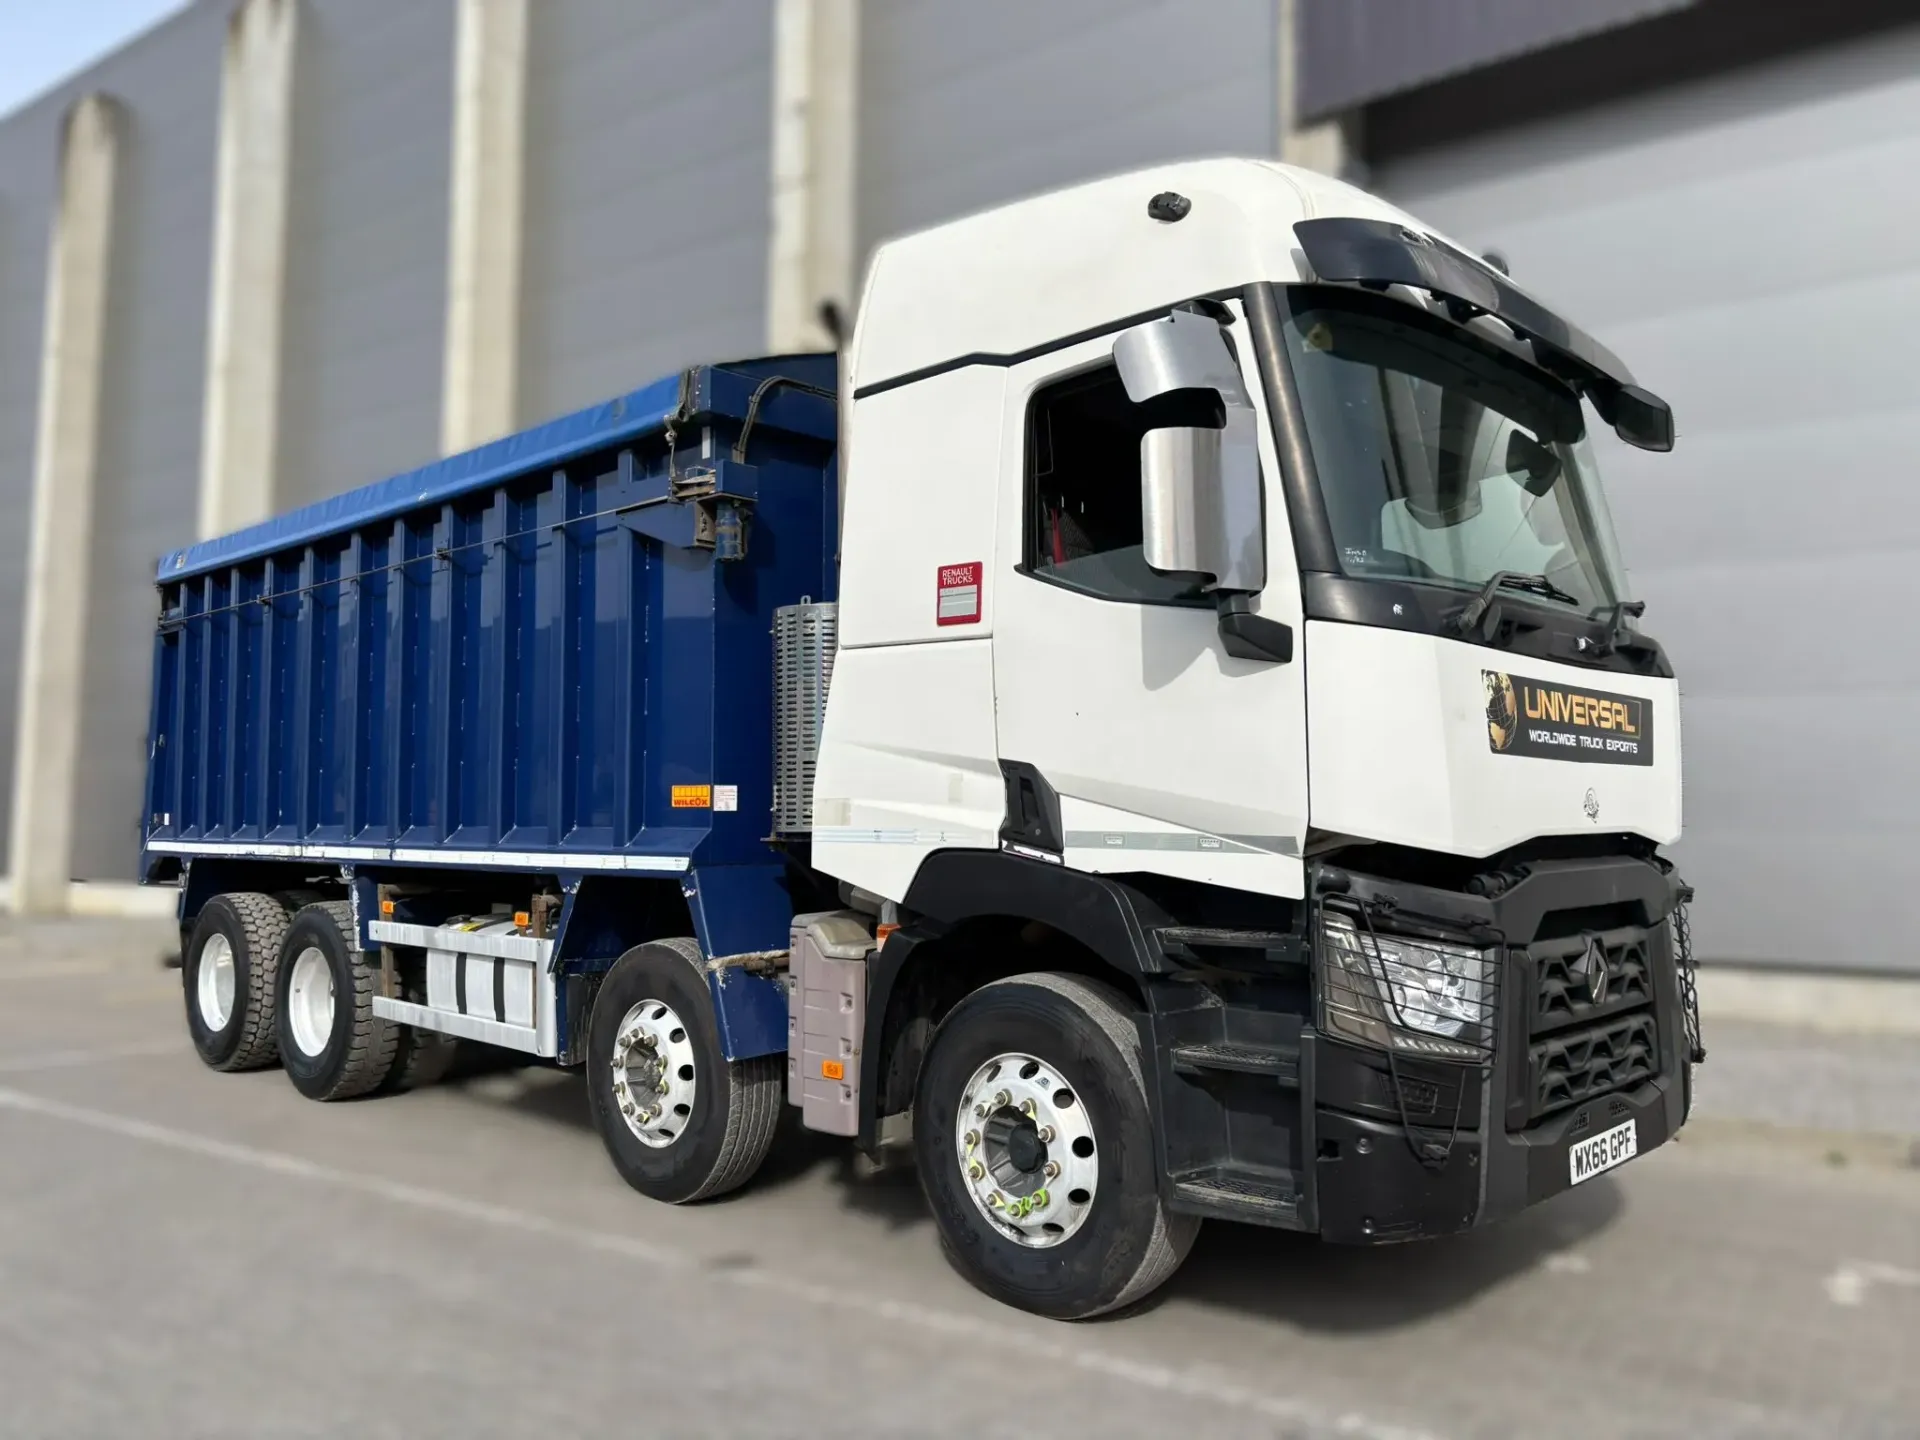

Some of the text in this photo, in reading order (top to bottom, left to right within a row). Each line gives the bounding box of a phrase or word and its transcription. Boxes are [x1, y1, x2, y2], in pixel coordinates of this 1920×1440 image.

[942, 575, 973, 586] TRUCKS
[943, 566, 973, 577] RENAULT
[1524, 686, 1636, 733] UNIVERSAL
[1528, 729, 1639, 754] WORLDWIDE TRUCK EXPORTS
[674, 798, 708, 806] WILCOX
[1575, 1126, 1631, 1178] WX66 GPF
